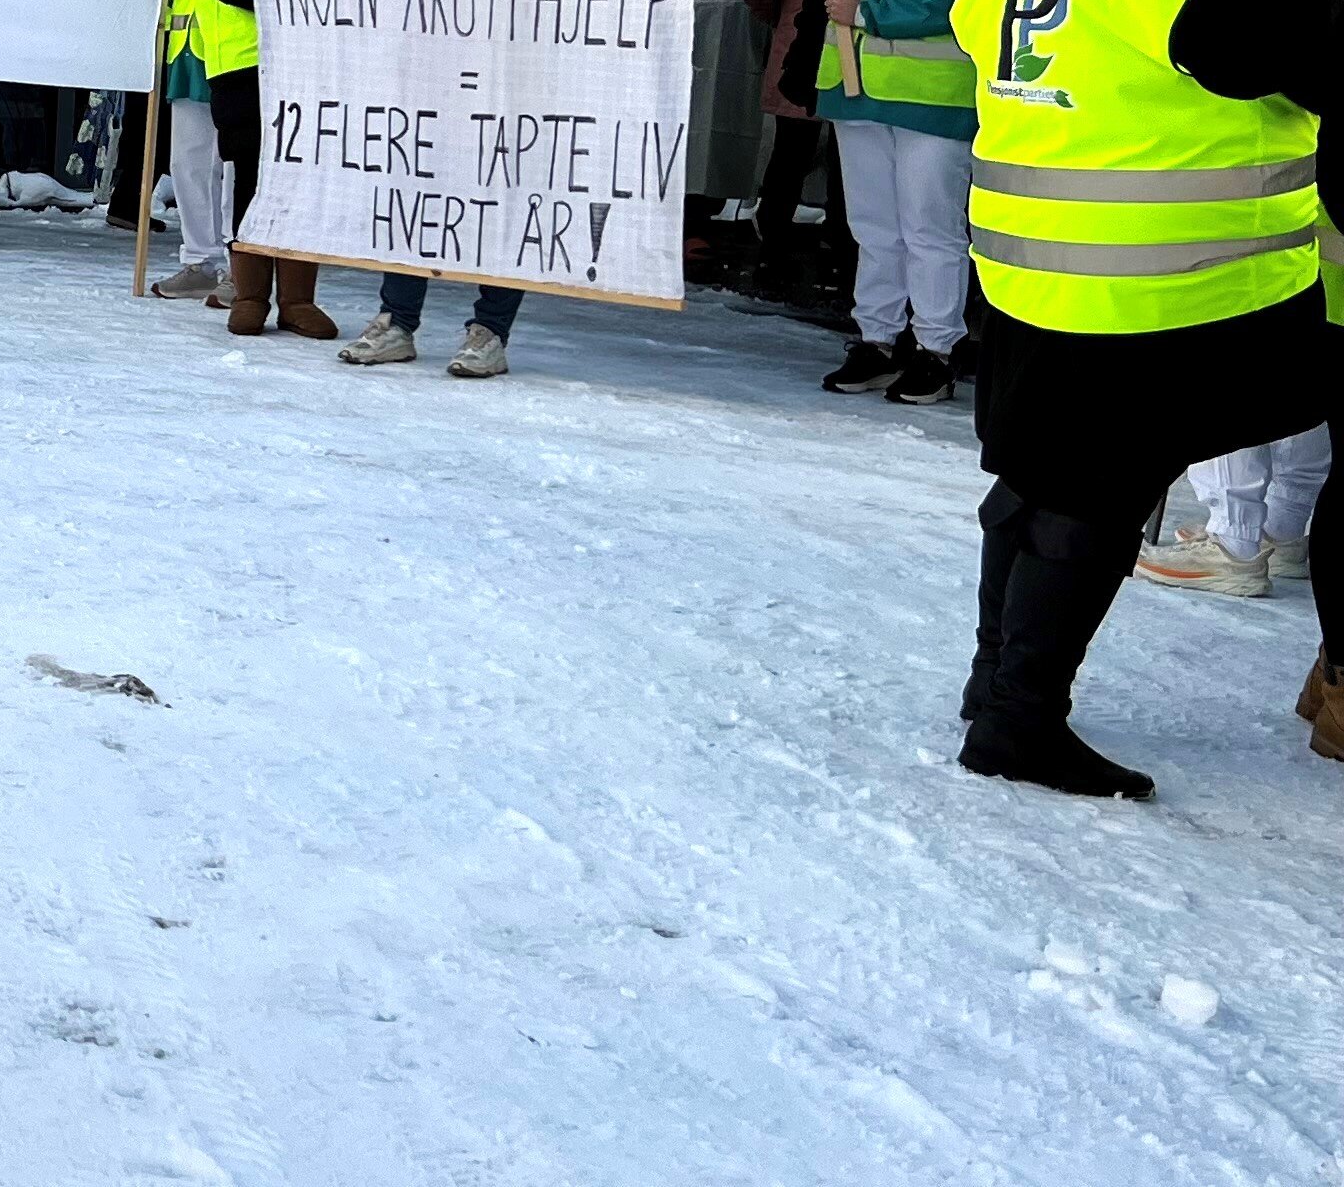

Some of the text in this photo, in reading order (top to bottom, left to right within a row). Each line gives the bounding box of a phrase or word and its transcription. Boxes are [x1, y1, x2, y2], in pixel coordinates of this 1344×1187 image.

[271, 99, 686, 204] 12 FLERE TAPTE LIV
[372, 185, 499, 268] HVERT
